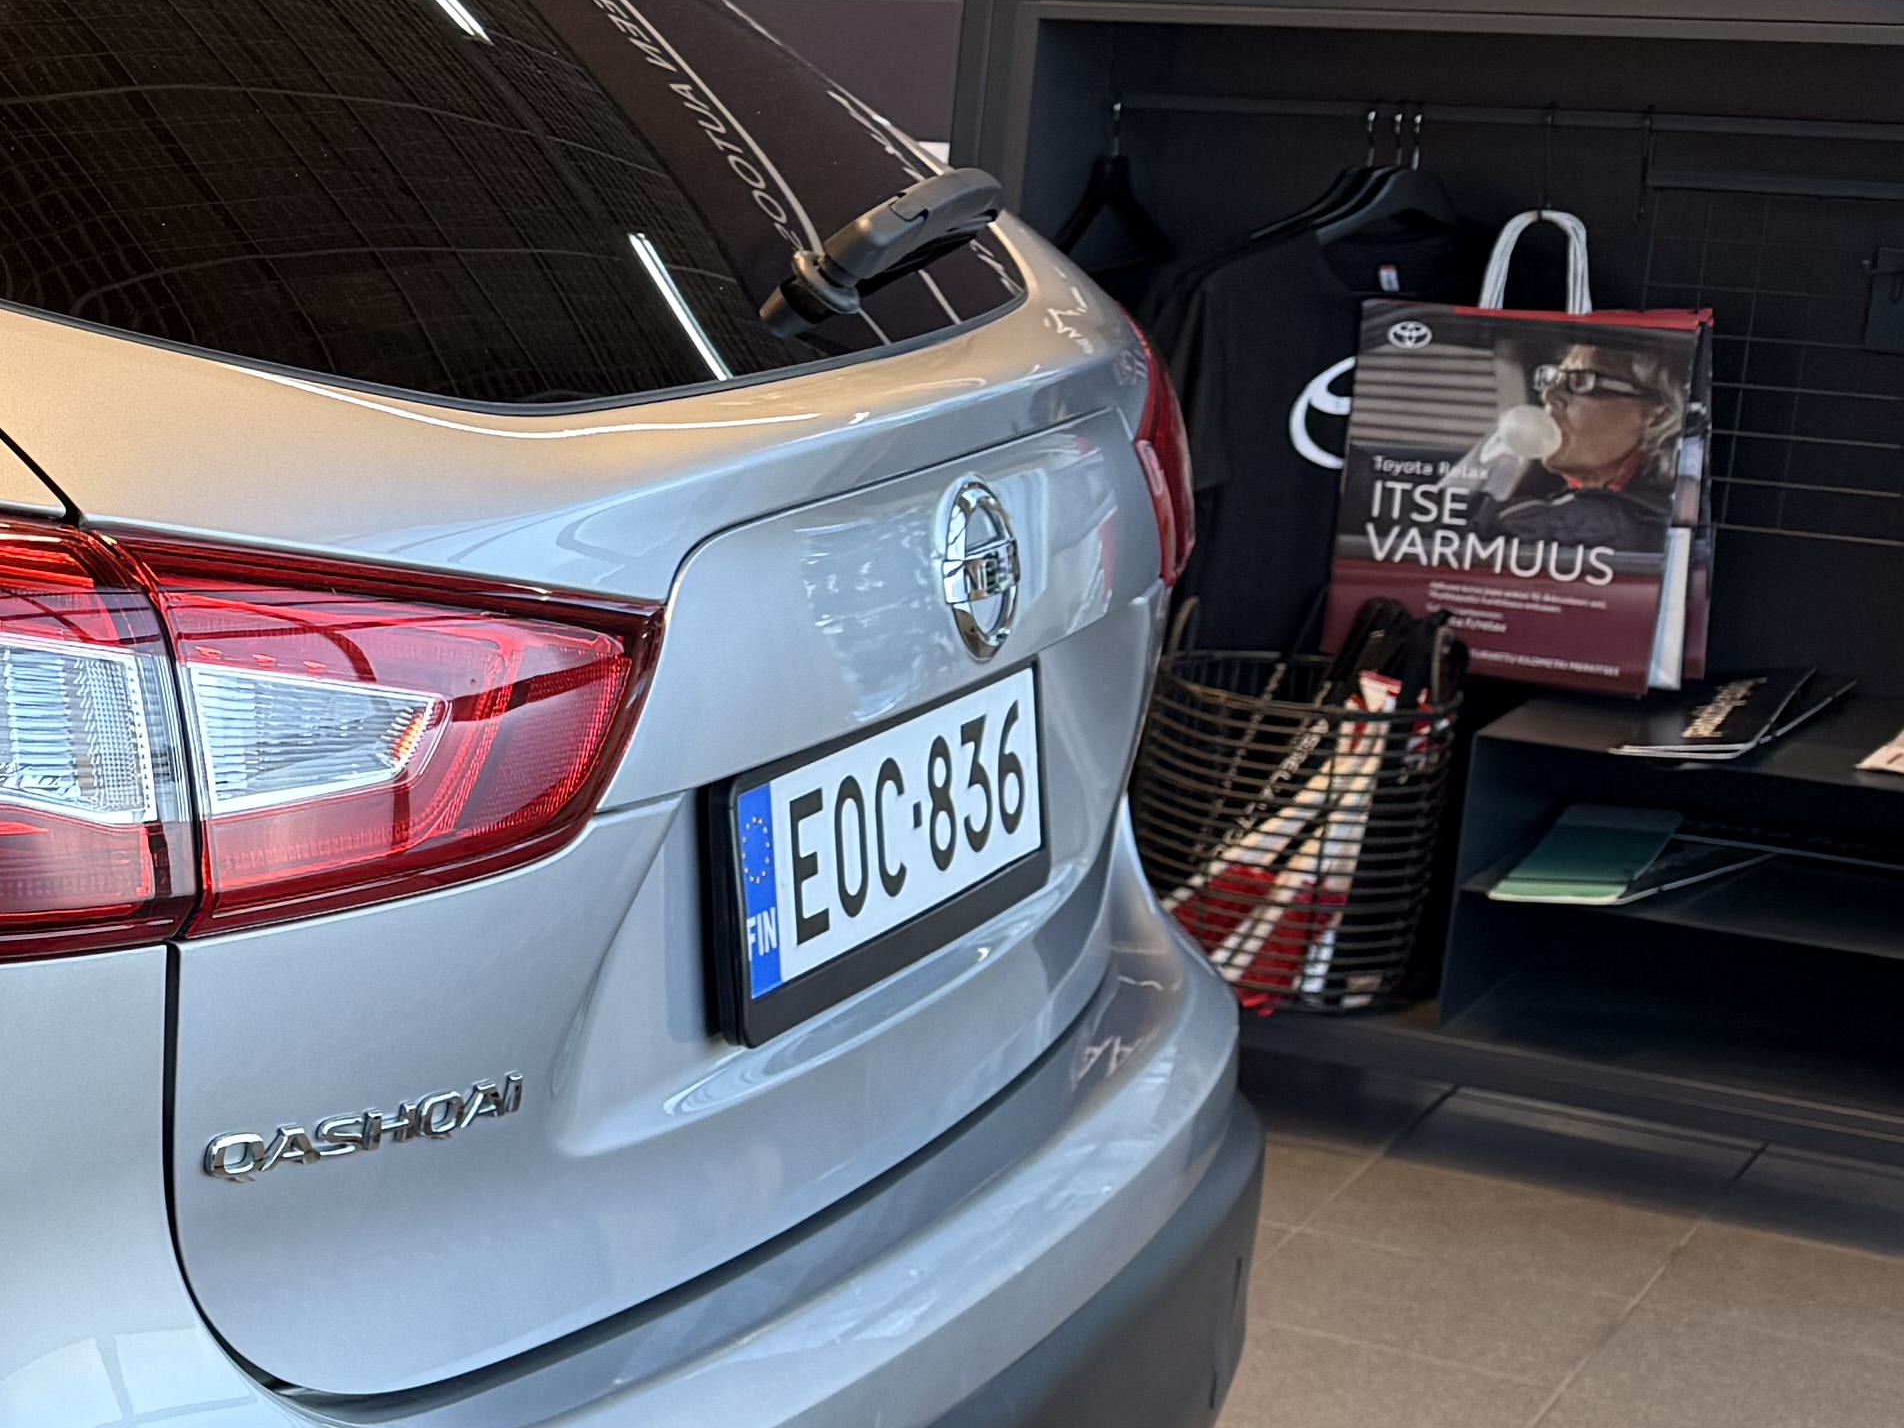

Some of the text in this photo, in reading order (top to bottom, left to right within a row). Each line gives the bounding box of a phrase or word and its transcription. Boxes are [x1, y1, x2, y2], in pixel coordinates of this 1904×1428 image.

[1371, 479, 1471, 527] ITSE
[1365, 521, 1616, 587] VARMUUS
[788, 700, 1024, 947] EOC-836
[746, 905, 778, 963] FIN
